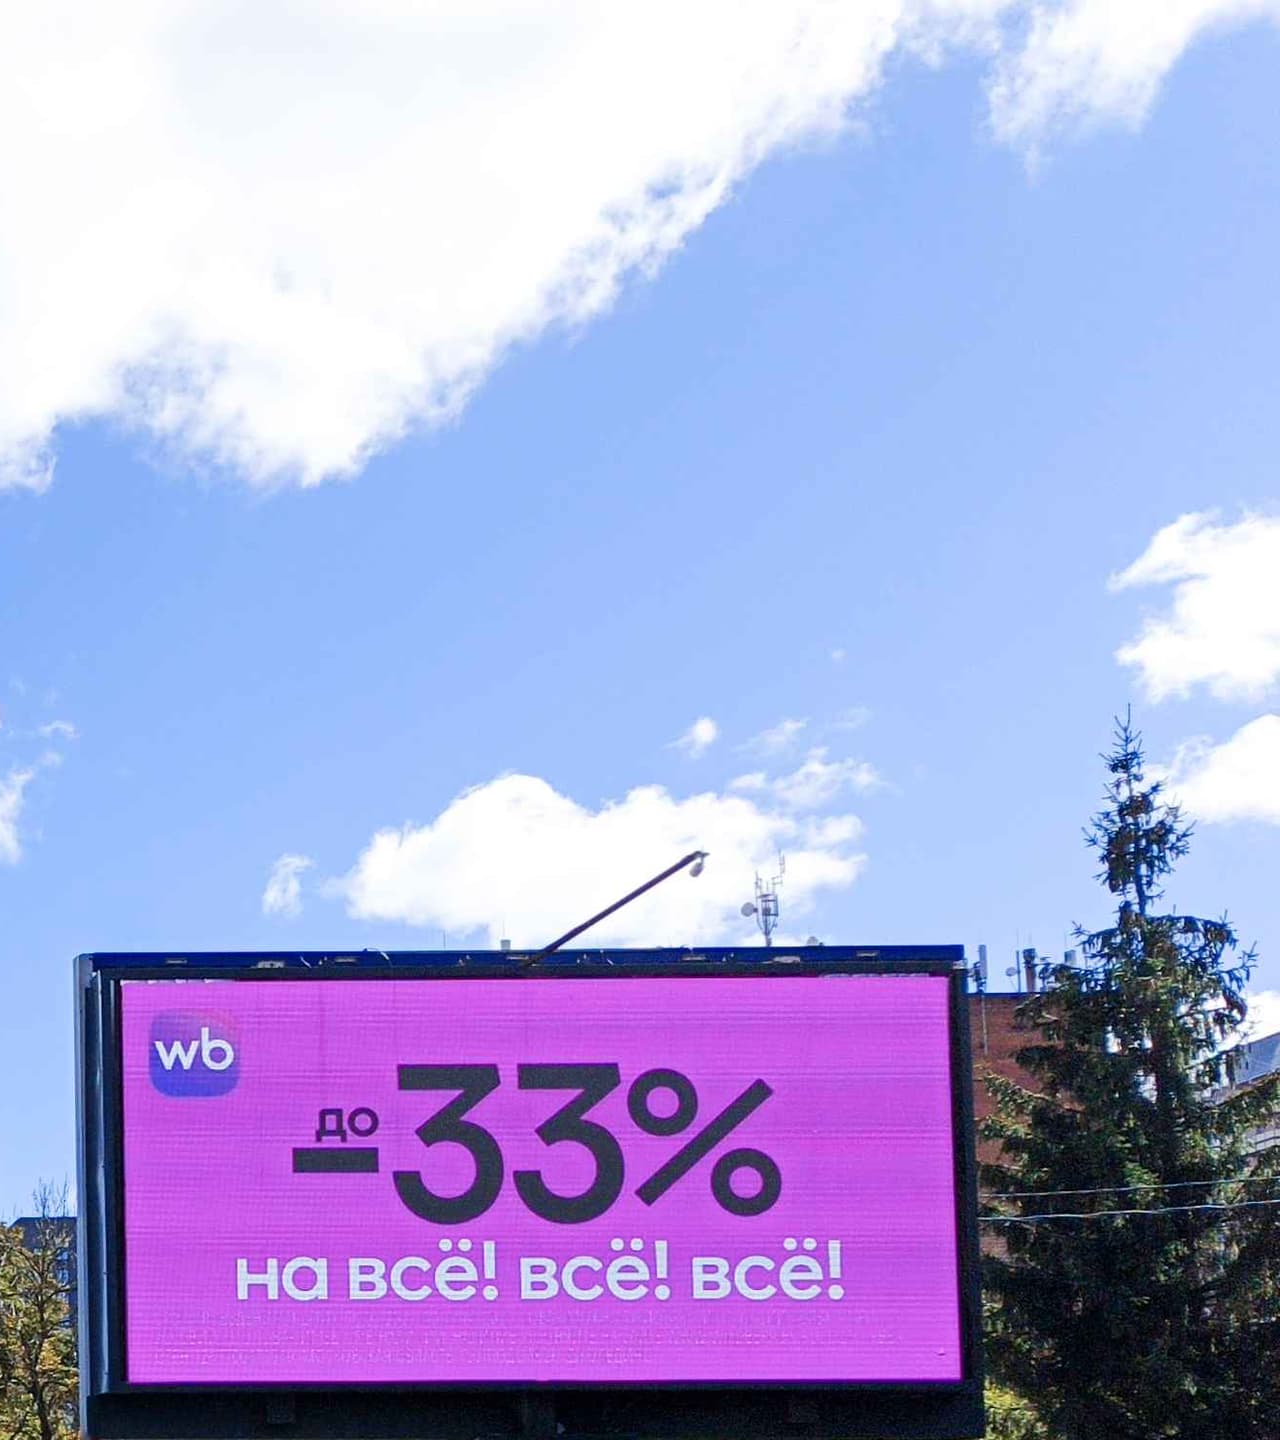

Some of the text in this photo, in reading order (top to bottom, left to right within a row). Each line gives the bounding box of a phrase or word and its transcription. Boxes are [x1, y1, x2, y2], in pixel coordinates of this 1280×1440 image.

[153, 1027, 235, 1070] wb
[315, 1107, 380, 1142] до
[236, 1237, 844, 1301] на всё! всё! всё!
